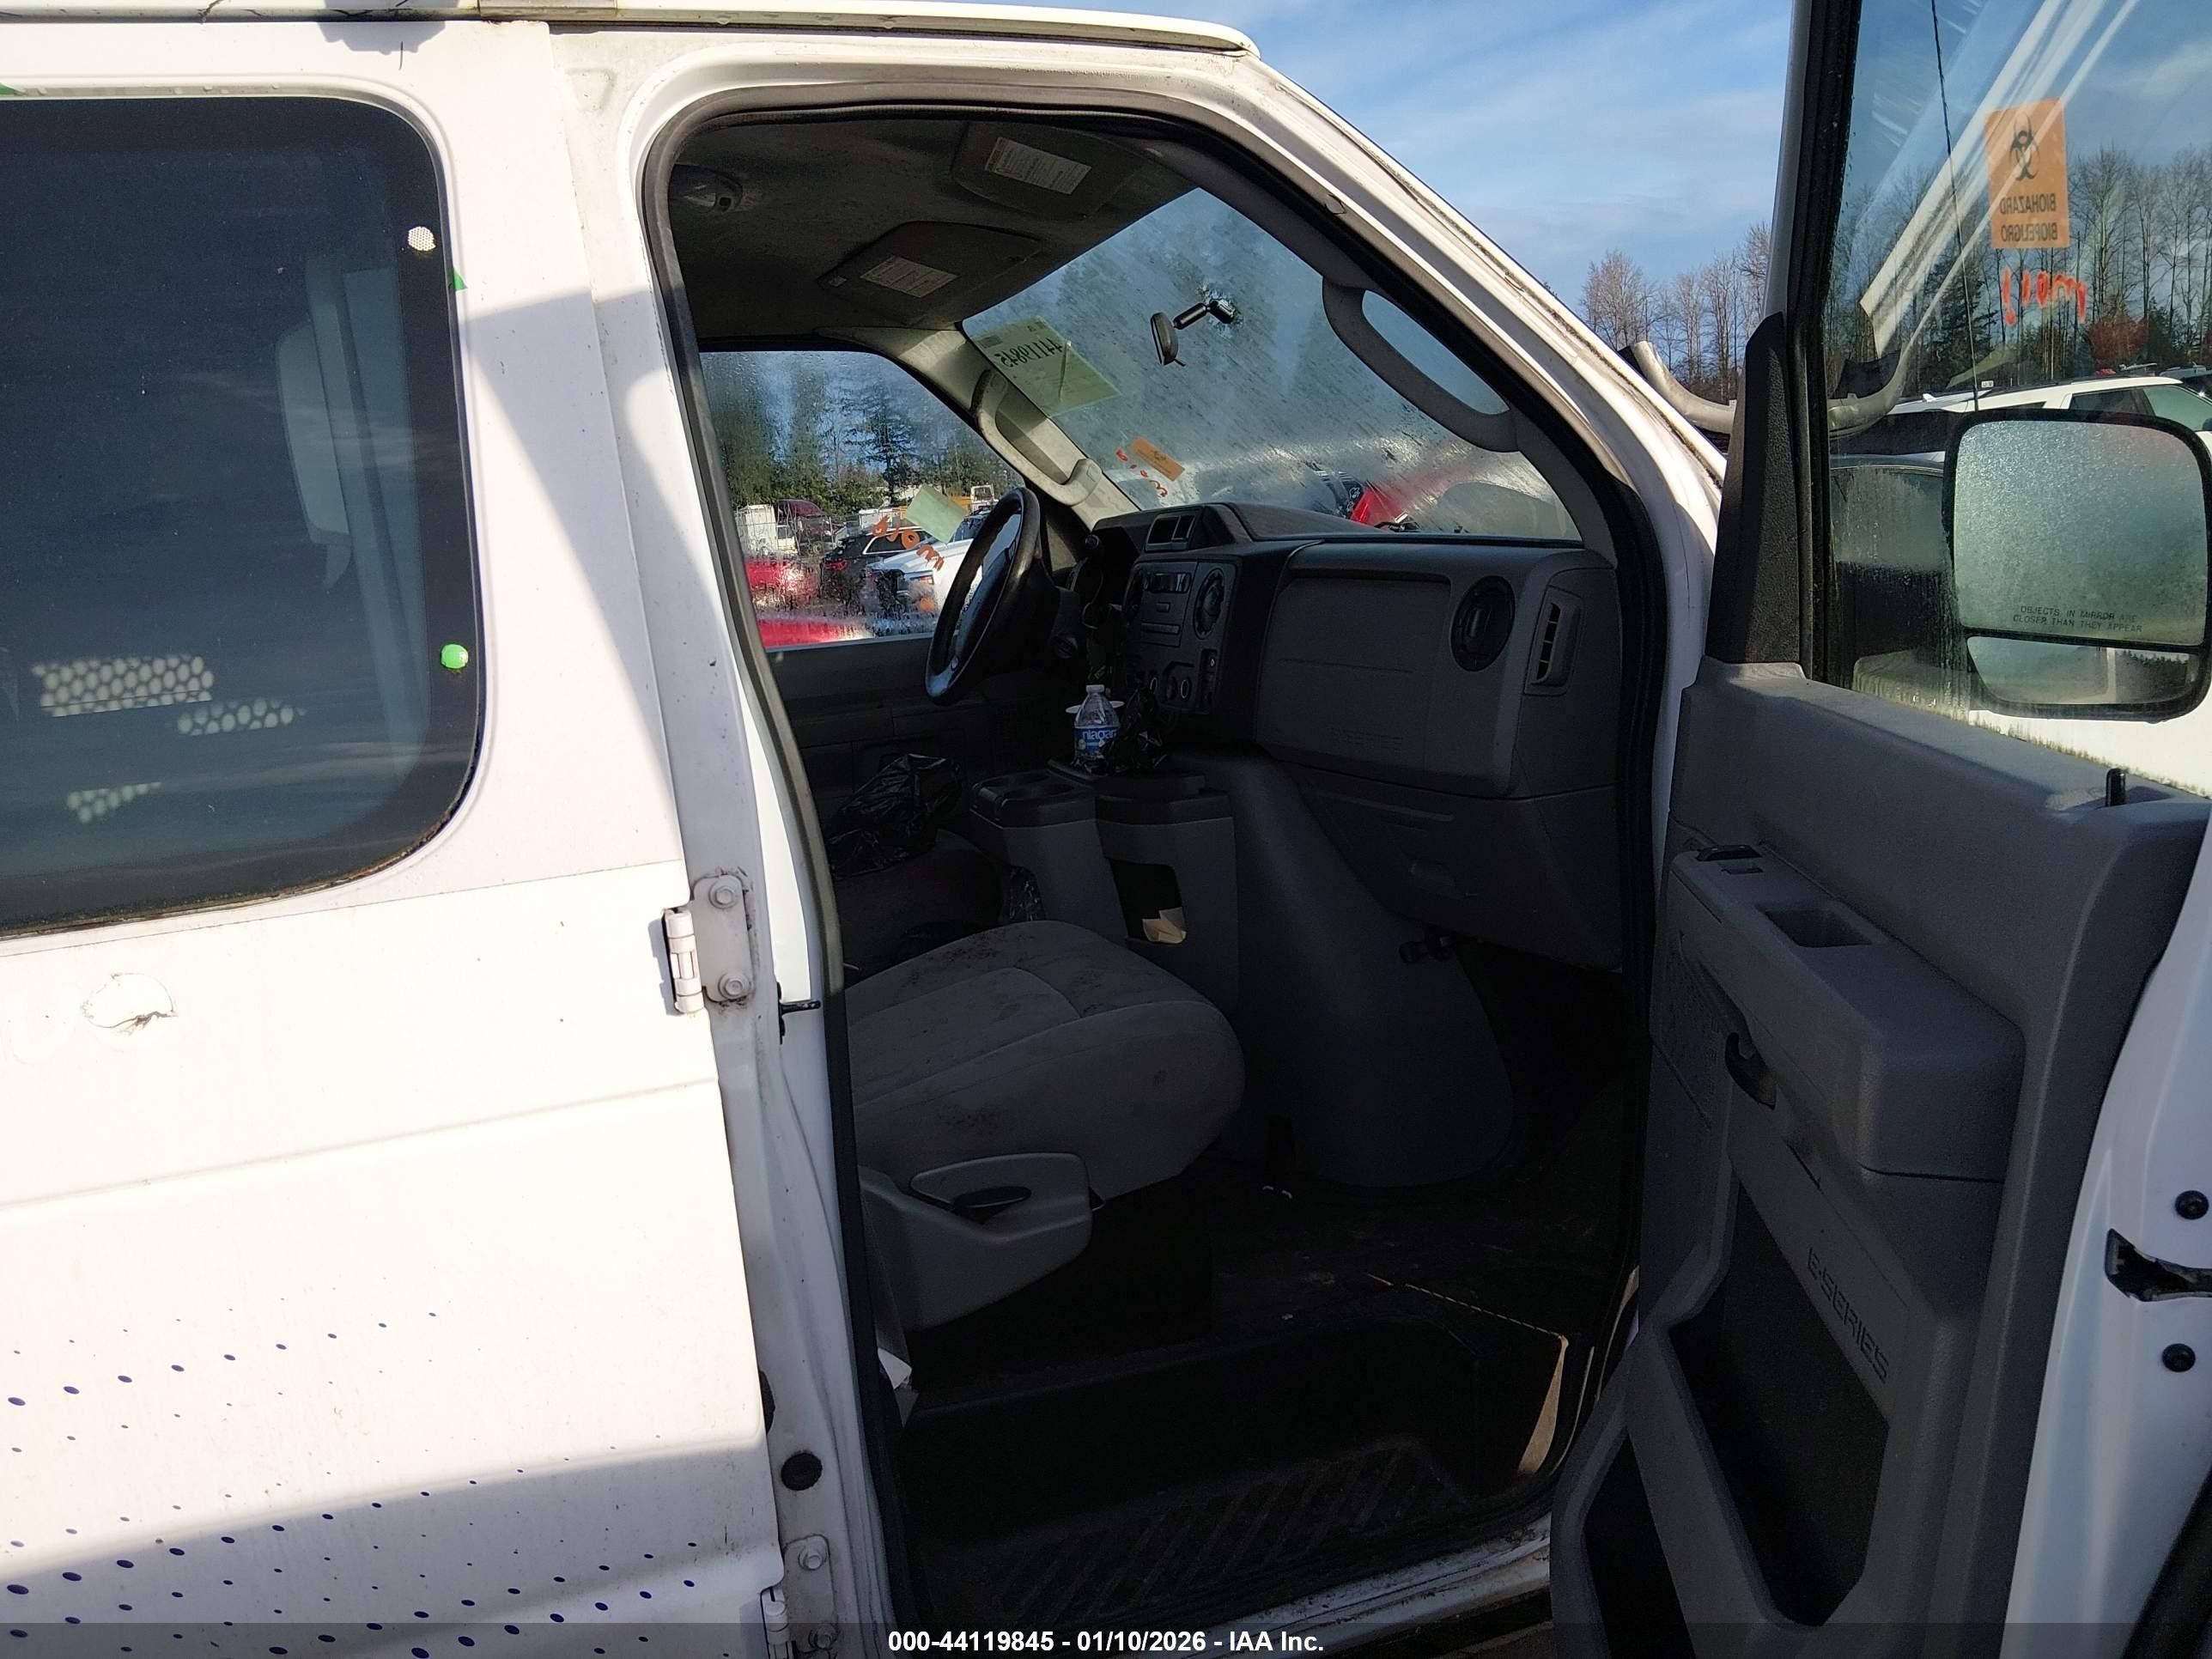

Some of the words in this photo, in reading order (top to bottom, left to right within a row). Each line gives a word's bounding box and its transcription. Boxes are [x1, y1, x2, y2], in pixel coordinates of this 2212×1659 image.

[2020, 605, 2060, 617] OBJECTS
[2067, 610, 2075, 618] IN
[2080, 611, 2115, 620] MIRROR
[2013, 615, 2047, 625] CLOSER
[2051, 617, 2075, 627] THAN
[2081, 621, 2102, 629] THEY
[2107, 623, 2143, 633] APPEAR
[1808, 1247, 1890, 1385] E-SERIES
